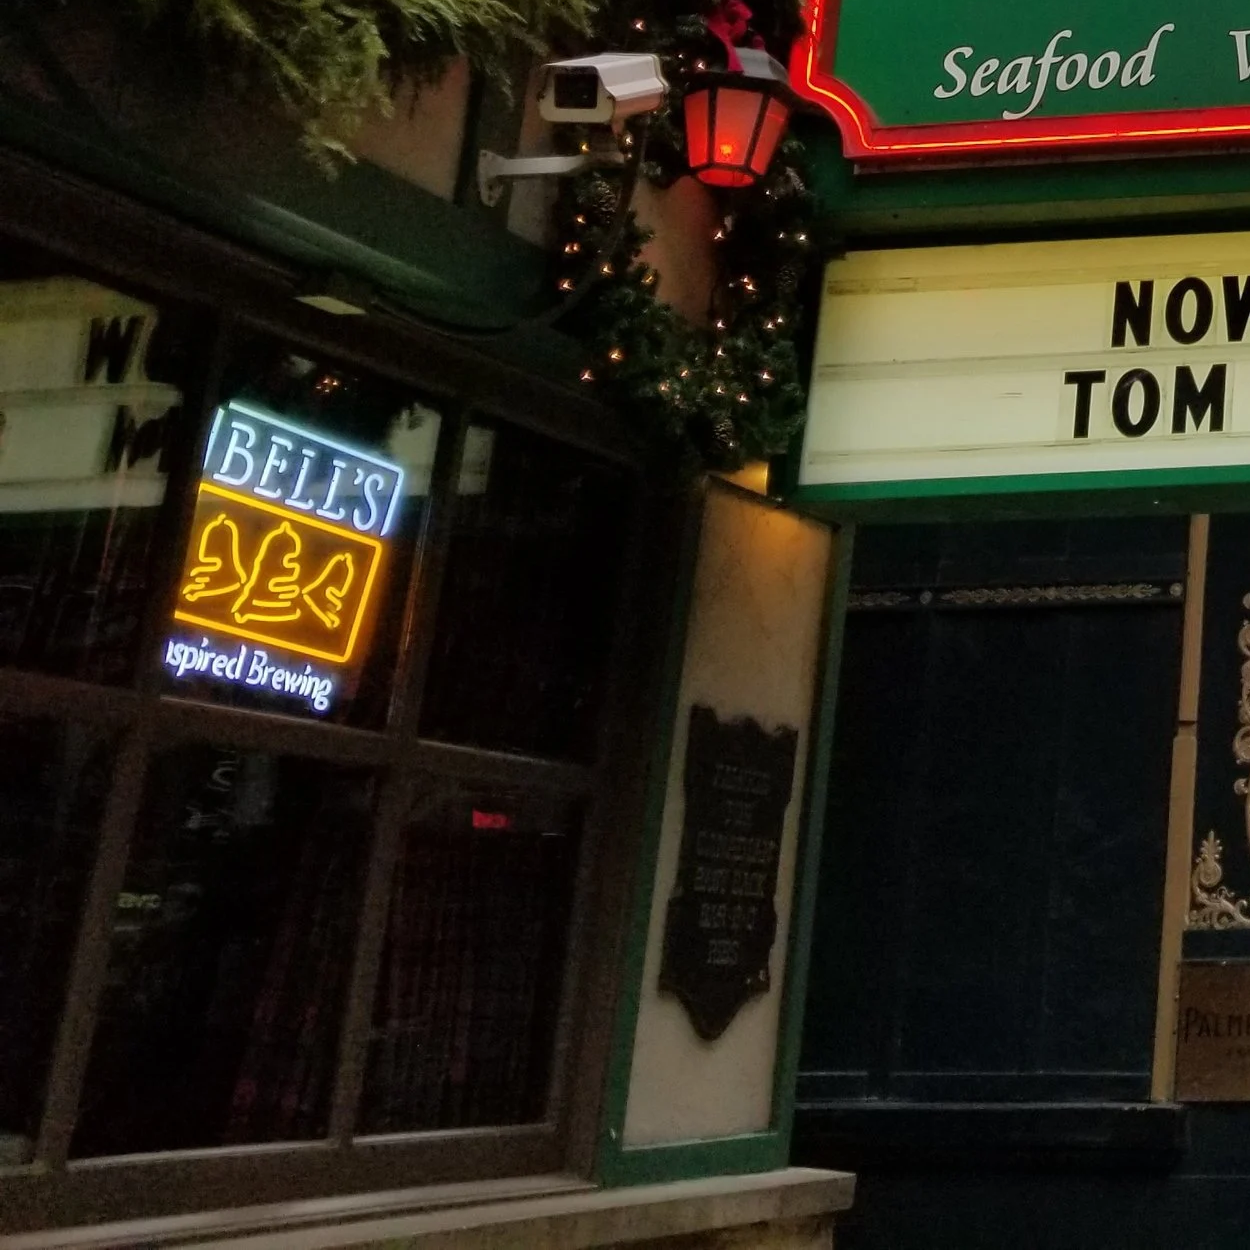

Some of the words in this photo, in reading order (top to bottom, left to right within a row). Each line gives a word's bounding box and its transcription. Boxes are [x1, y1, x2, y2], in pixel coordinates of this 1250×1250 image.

[933, 23, 1175, 120] Seafood
[1065, 364, 1226, 439] TOM
[212, 421, 384, 532] BELL'S
[245, 650, 333, 711] Brewing
